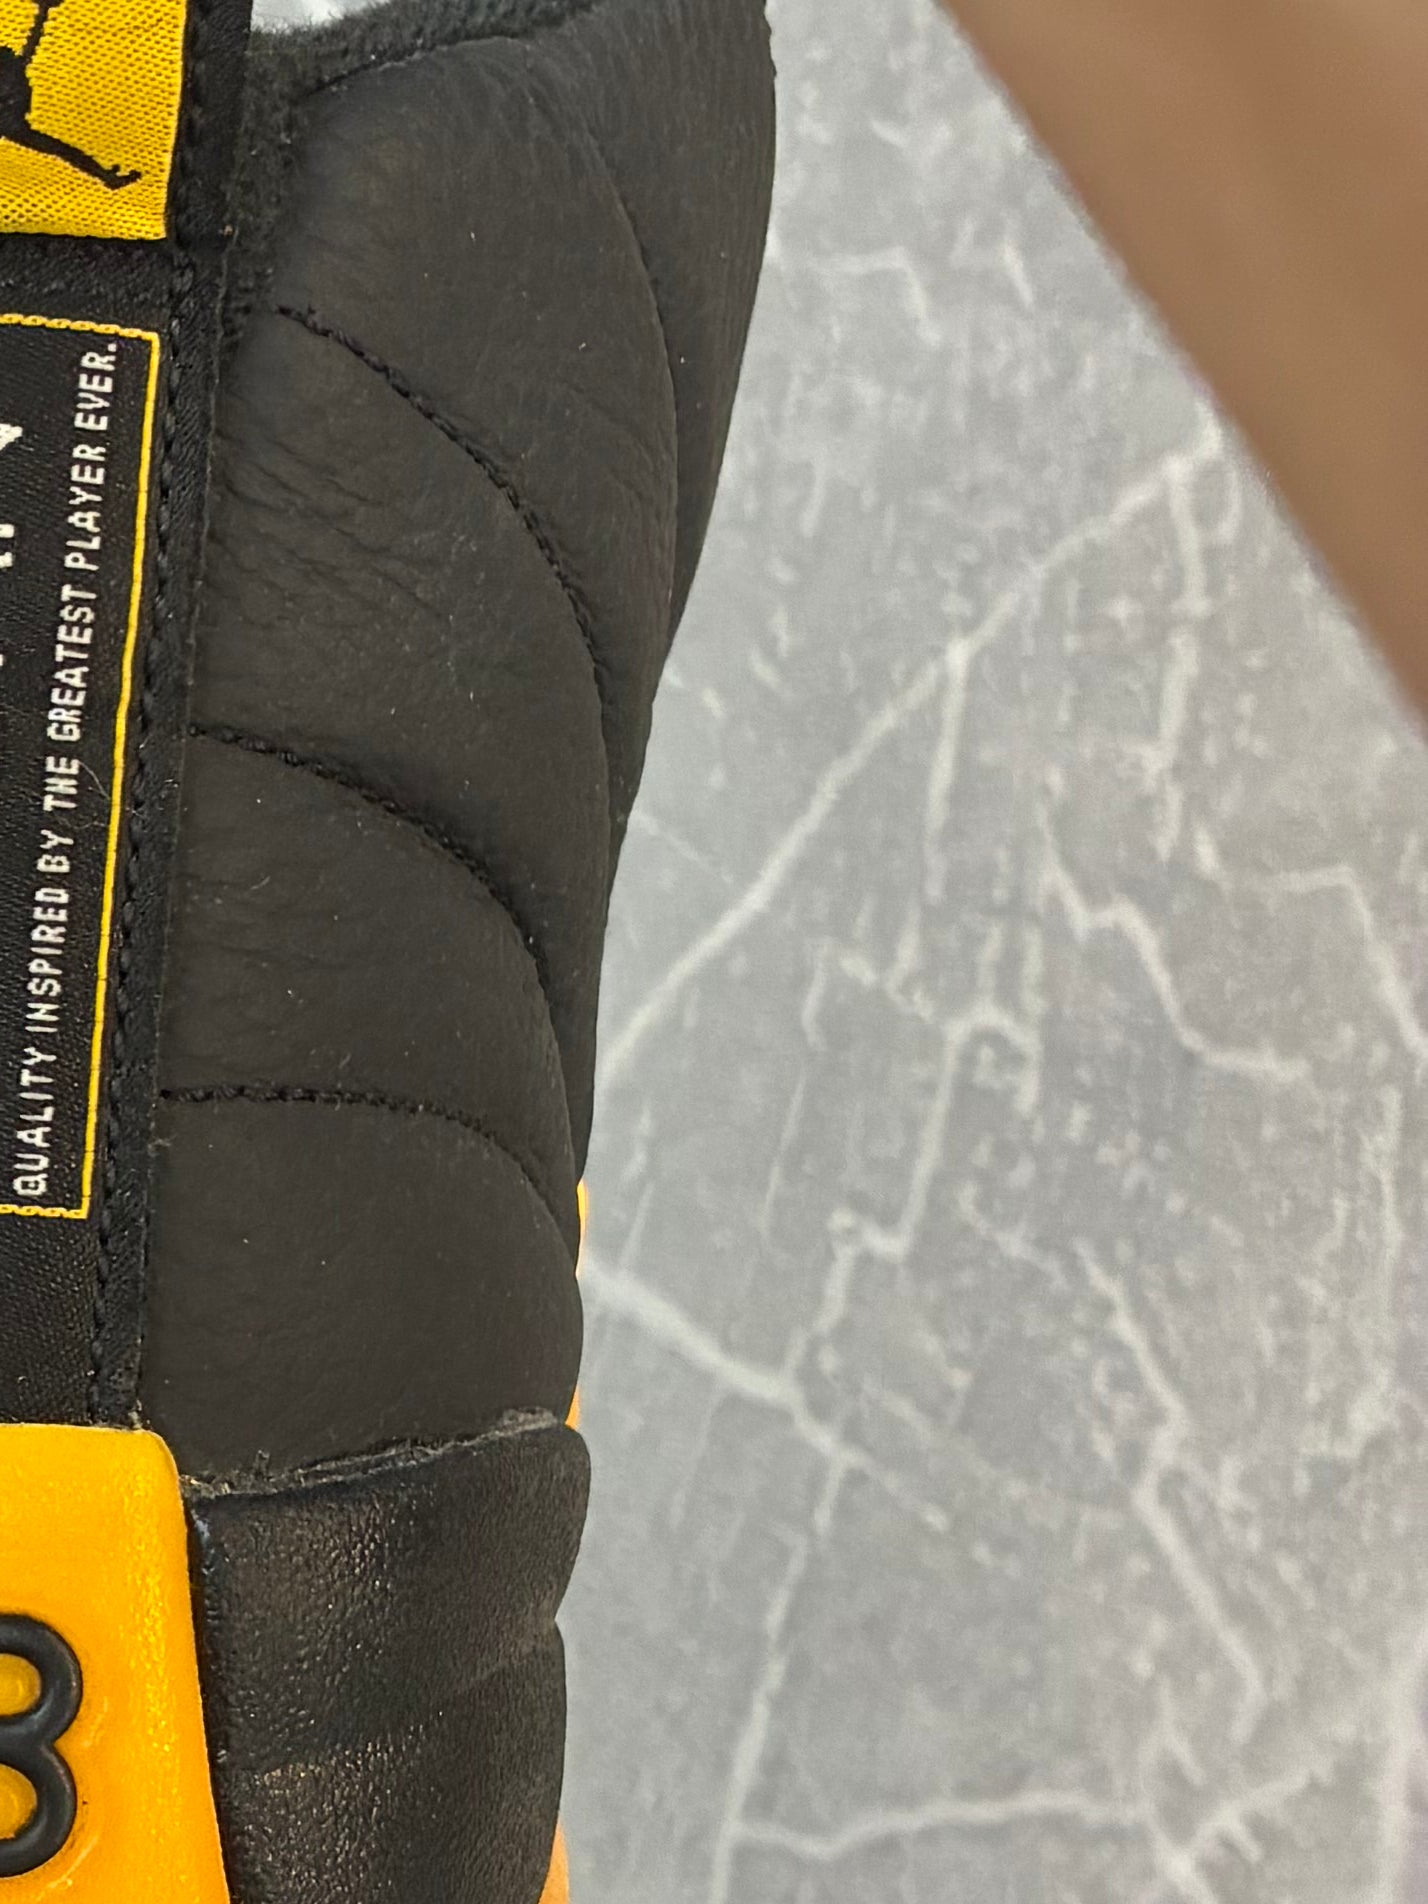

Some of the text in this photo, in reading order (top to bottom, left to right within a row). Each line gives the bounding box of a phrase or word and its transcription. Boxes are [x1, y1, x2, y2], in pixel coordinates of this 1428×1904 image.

[12, 342, 117, 1196] QUALITY INSPIRED BY THE GREATEST PLAYER EVER.
